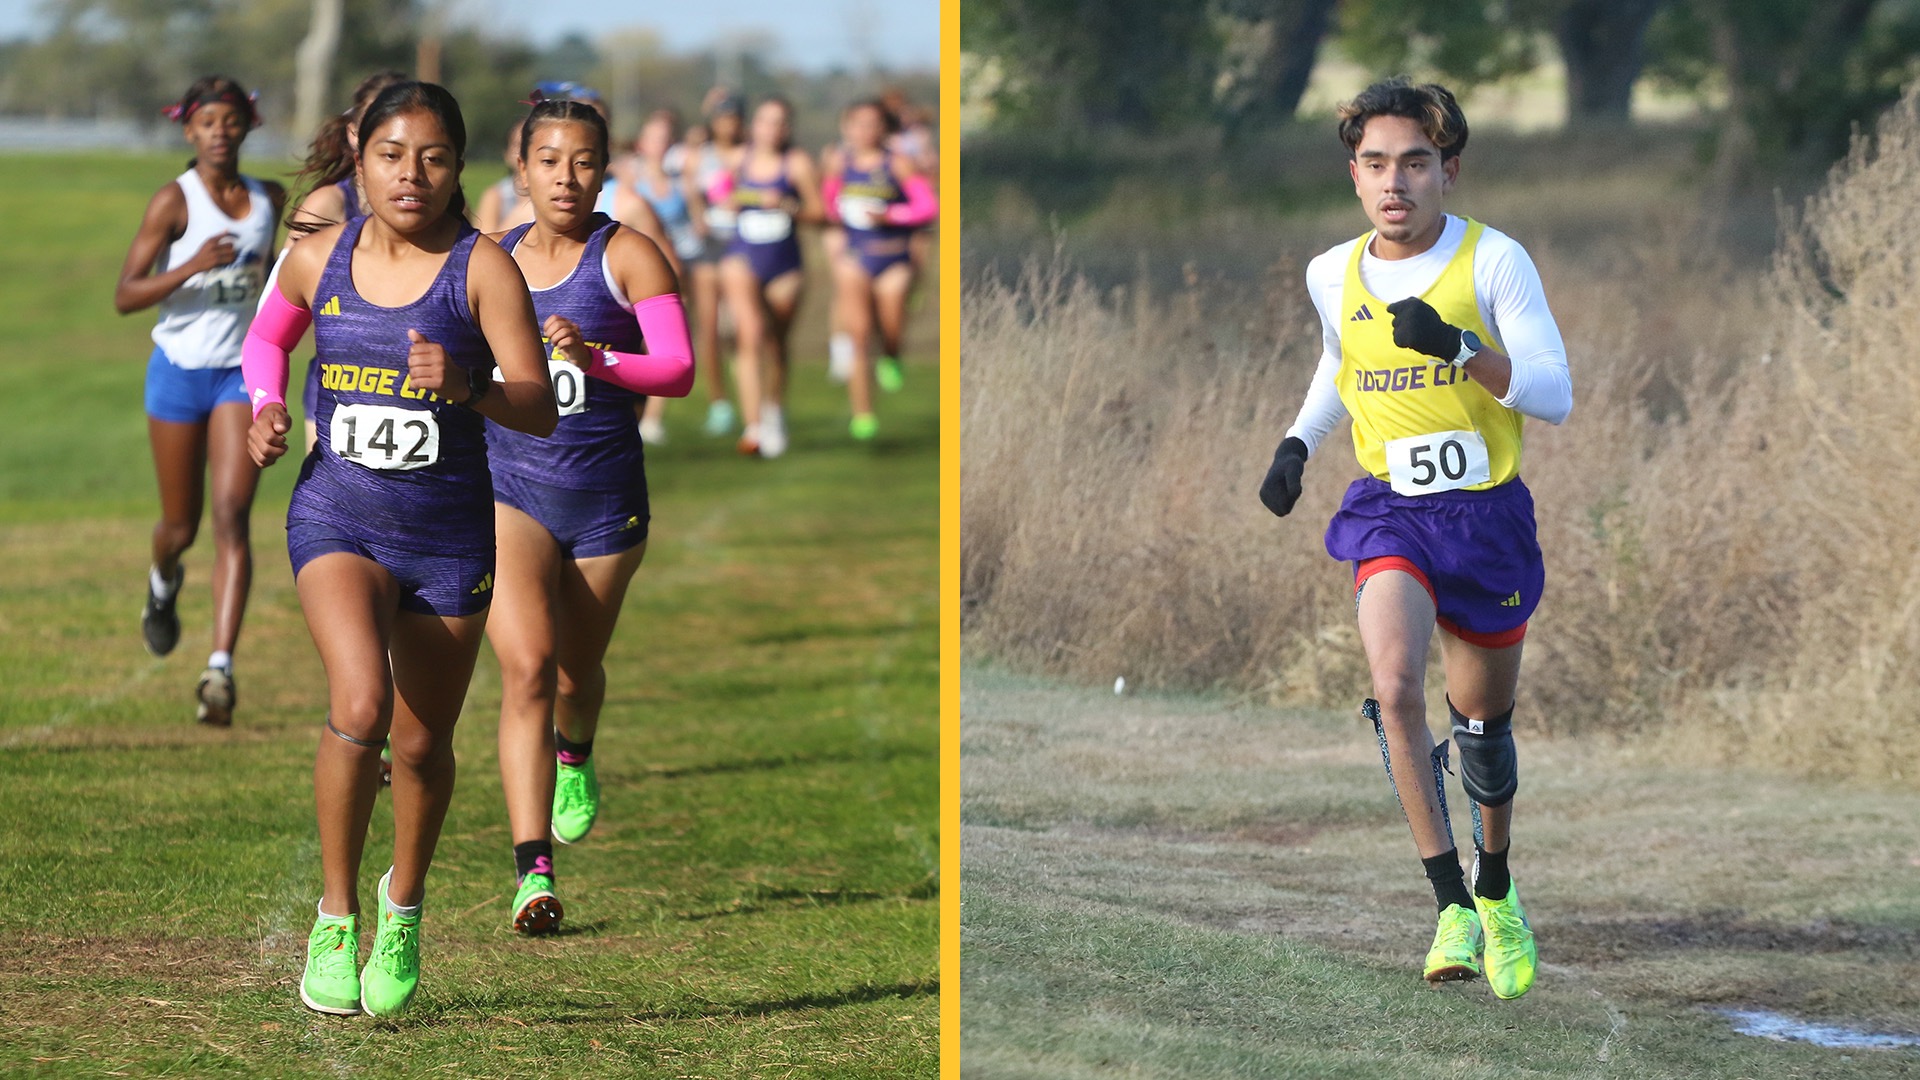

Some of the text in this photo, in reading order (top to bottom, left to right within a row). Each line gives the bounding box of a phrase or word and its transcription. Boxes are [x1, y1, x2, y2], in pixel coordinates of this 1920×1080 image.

[320, 363, 400, 396] DODGE
[1355, 363, 1469, 392] DODGE CI
[339, 416, 430, 462] 142
[1409, 439, 1467, 486] 50
